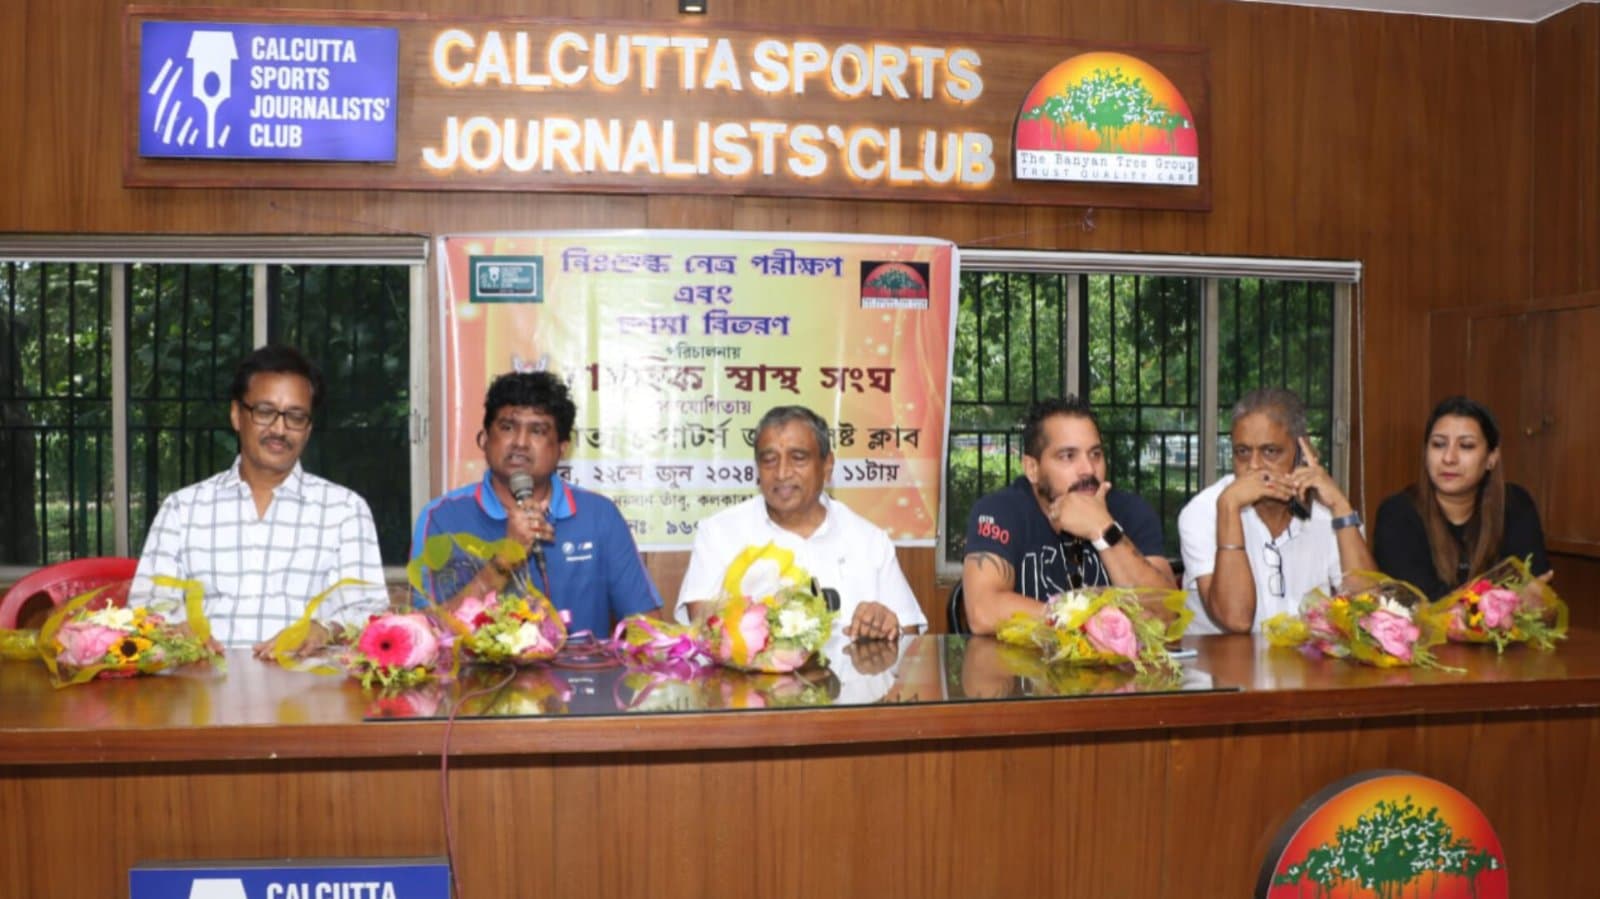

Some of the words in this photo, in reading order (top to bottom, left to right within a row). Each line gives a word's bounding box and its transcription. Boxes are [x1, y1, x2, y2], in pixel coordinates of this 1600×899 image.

[251, 37, 357, 63] CALCUTTA
[250, 66, 330, 91] SPORTS
[433, 30, 741, 91] CALCUTTA
[750, 40, 983, 102] SPORTS
[250, 95, 391, 121] JOURNALISTS'
[250, 124, 303, 148] CLUB
[848, 127, 995, 183] CLUB
[1020, 151, 1046, 165] The
[1055, 153, 1108, 168] Banyan
[1116, 156, 1147, 169] Tree
[1155, 157, 1194, 172] Group
[1022, 167, 1070, 178] TRUST
[685, 253, 738, 275] নেত্র
[751, 248, 844, 277] পরীক্ষণ
[673, 284, 734, 305] এবং
[704, 308, 790, 336] বিতরণ
[820, 367, 895, 393] সংঘ
[867, 425, 922, 450] ক্লাব
[656, 464, 693, 488] জুন
[976, 520, 1010, 545] 1890
[266, 881, 397, 899] CALCUTTA
